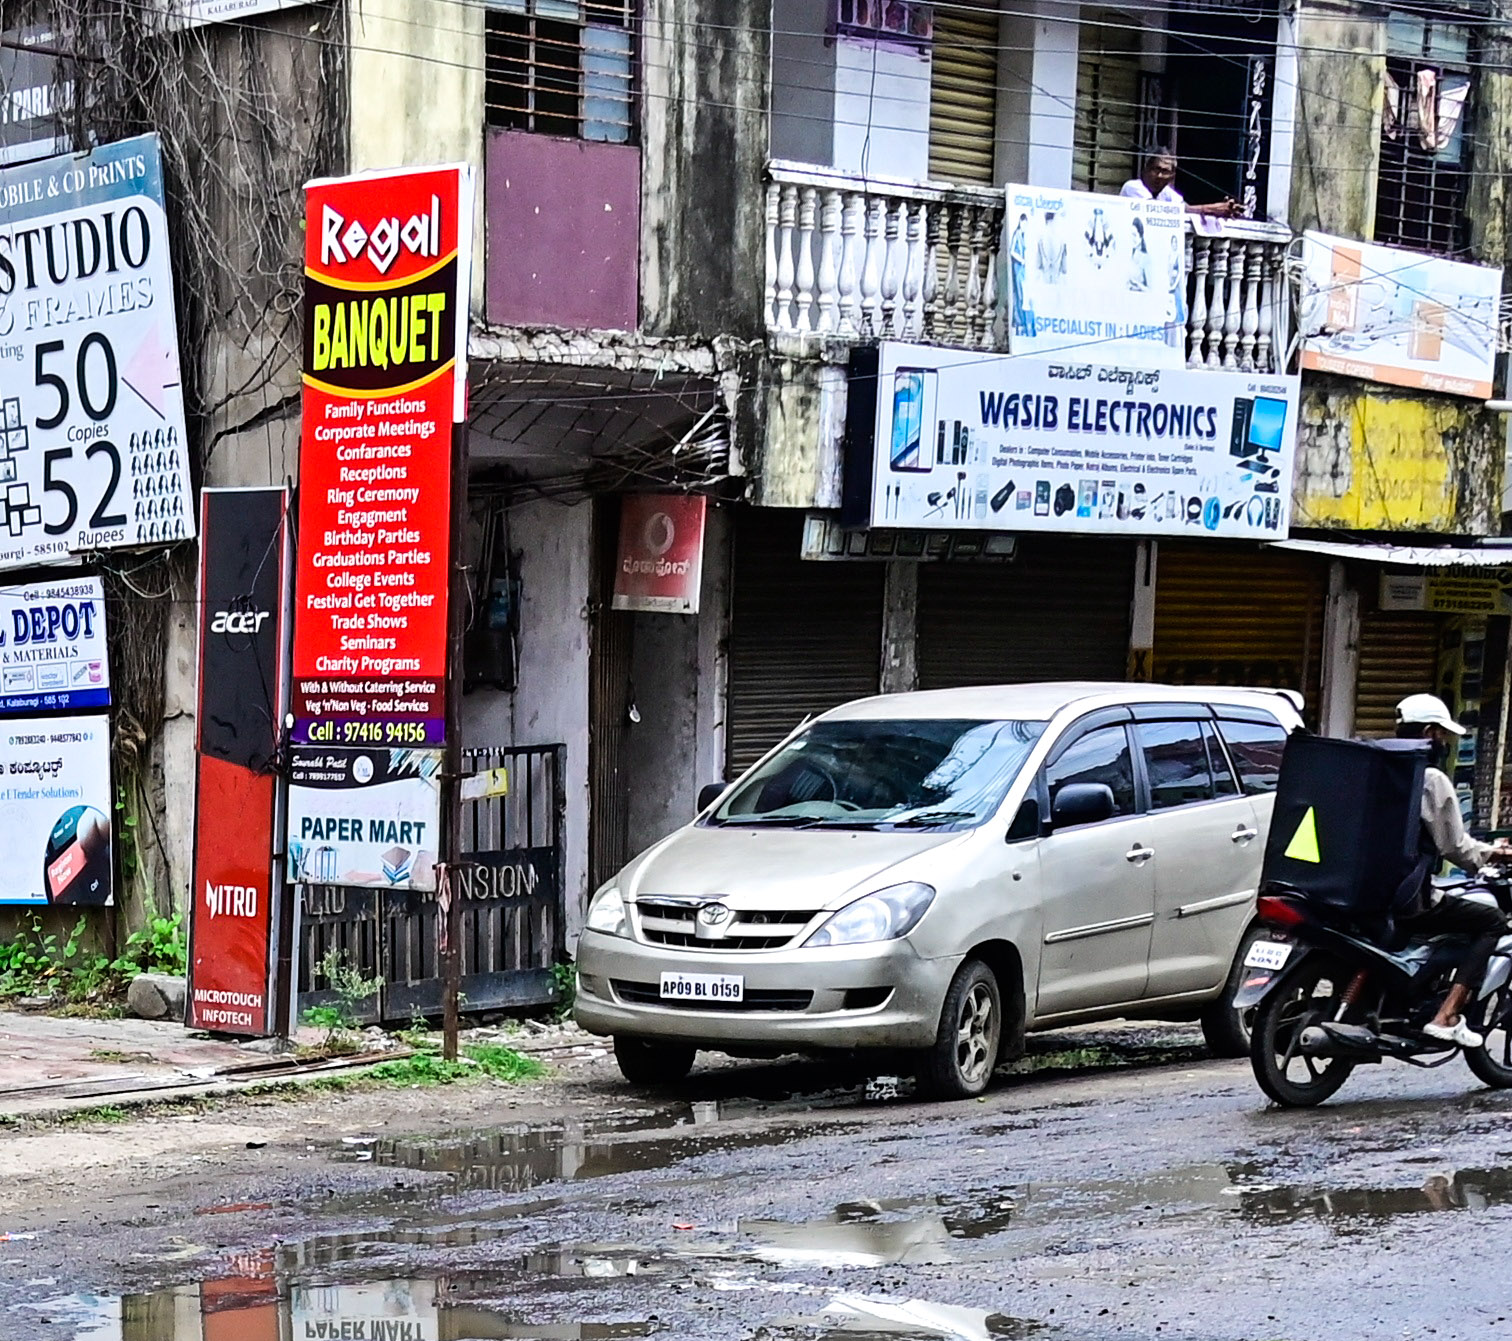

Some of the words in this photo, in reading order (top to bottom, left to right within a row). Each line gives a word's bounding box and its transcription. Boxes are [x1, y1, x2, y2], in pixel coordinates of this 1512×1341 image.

[63, 169, 87, 194] CD
[88, 154, 147, 187] PRINTS
[321, 194, 440, 274] Regal
[313, 292, 446, 371] BANQUET
[1036, 316, 1102, 337] SPECIALIST
[34, 332, 118, 431] 50
[325, 401, 364, 420] Family
[366, 398, 426, 416] Functions
[979, 390, 1059, 431] WASIB
[1067, 396, 1217, 441] ELECTRONICS
[67, 422, 109, 444] Copies
[315, 423, 375, 443] Corporate
[378, 419, 436, 439] Meetings
[336, 443, 412, 461] Confarances
[340, 464, 407, 485] Receptions
[43, 441, 128, 536] 52
[327, 488, 354, 508] Ring
[356, 486, 420, 504] Ceremony
[337, 508, 407, 528] Engagment
[77, 527, 125, 549] Rupees
[324, 528, 375, 548] Birthday
[378, 527, 421, 544] Parties
[313, 550, 385, 568] Graduations
[387, 548, 431, 565] Parties
[326, 571, 371, 591] College
[374, 571, 415, 586] Events
[307, 592, 352, 610] Festival
[354, 592, 376, 608] Get
[378, 591, 434, 612] Together
[12, 600, 97, 647] DEPOT
[210, 610, 270, 634] acer
[330, 613, 365, 629] Trade
[367, 613, 408, 629] Shows
[340, 634, 396, 650] Seminars
[13, 645, 79, 663] MATERIALS
[316, 656, 359, 675] Charity
[361, 657, 421, 676] Programs
[329, 681, 364, 693] Without
[404, 680, 436, 694] Service
[305, 699, 321, 715] Veg
[350, 699, 367, 715] Veg
[372, 698, 393, 712] Food
[394, 698, 429, 712] Services
[308, 721, 334, 741] Cell
[344, 721, 383, 743] 97416
[385, 721, 426, 743] 94156
[301, 816, 363, 842] PAPER
[369, 819, 426, 846] MART
[205, 880, 257, 920] NITRO
[194, 987, 262, 1008] MICROTOUCH
[662, 981, 691, 997] AP09
[694, 982, 710, 997] BL
[712, 981, 740, 998] 0159
[201, 1008, 253, 1027] INFOTECH
